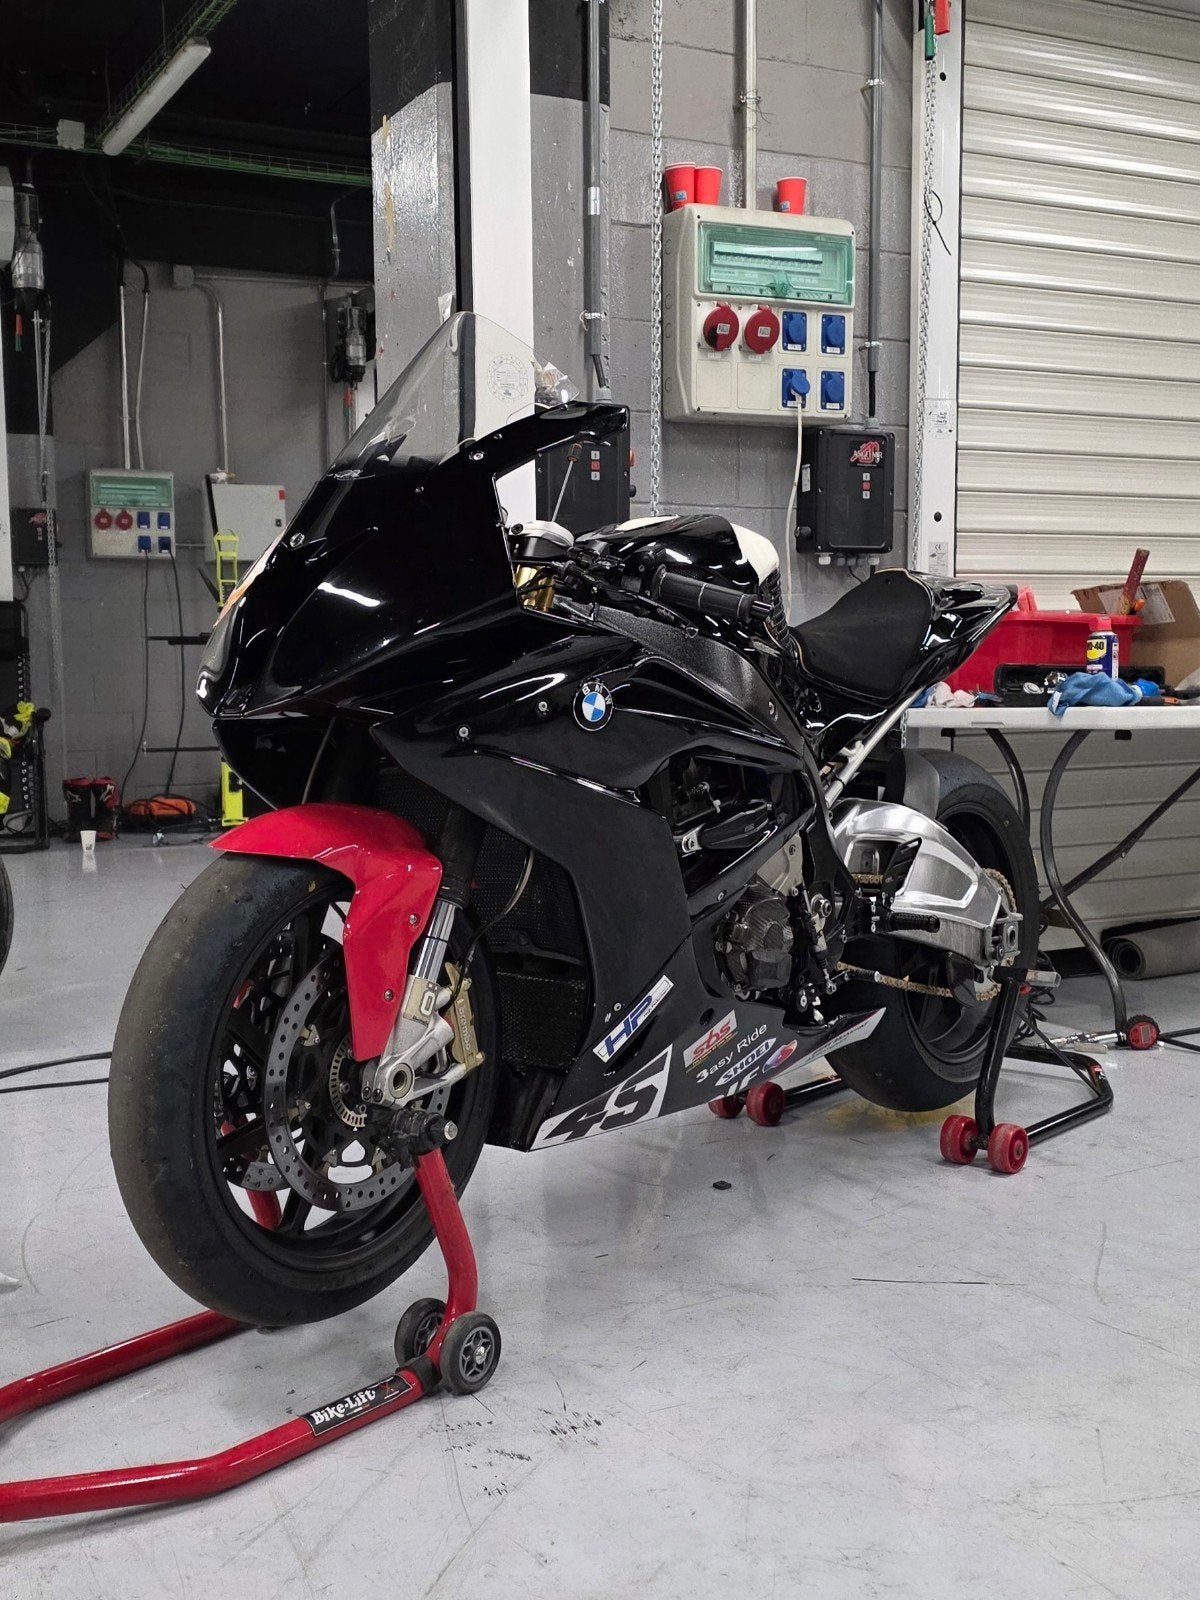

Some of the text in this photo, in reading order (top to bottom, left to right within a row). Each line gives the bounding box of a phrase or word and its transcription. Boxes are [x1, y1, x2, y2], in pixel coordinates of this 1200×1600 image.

[1087, 641, 1105, 650] D-40
[582, 683, 612, 705] BMW
[604, 995, 652, 1057] HP
[692, 1020, 731, 1057] sbs
[696, 1052, 733, 1084] 3asy
[736, 1024, 768, 1053] Ride
[719, 1040, 771, 1083] SHOEI
[310, 1389, 376, 1425] Bike-Lift
